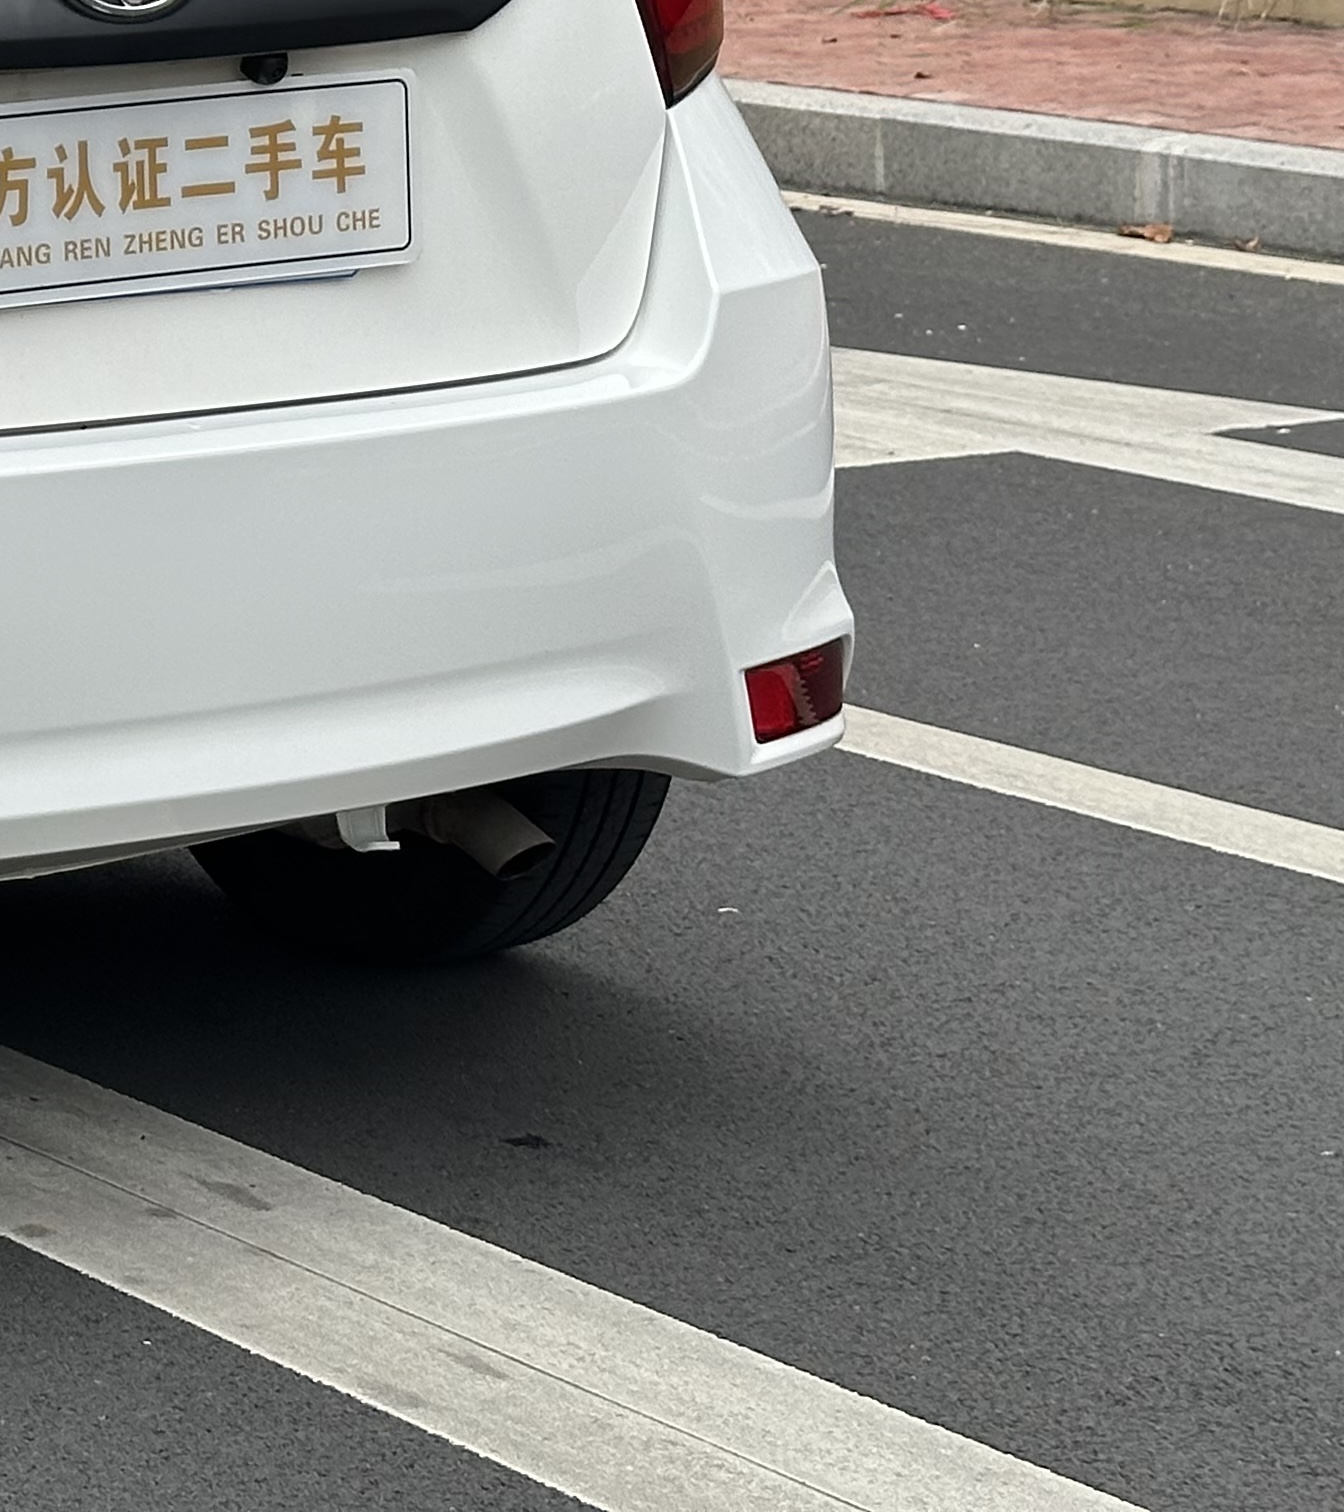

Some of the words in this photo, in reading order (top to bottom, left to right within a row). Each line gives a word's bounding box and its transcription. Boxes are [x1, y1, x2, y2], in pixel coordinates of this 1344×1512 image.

[63, 236, 111, 262] REN
[123, 226, 204, 256] ZHENG
[216, 222, 246, 246] ER
[257, 213, 324, 241] SHOU
[335, 207, 382, 233] CHE
